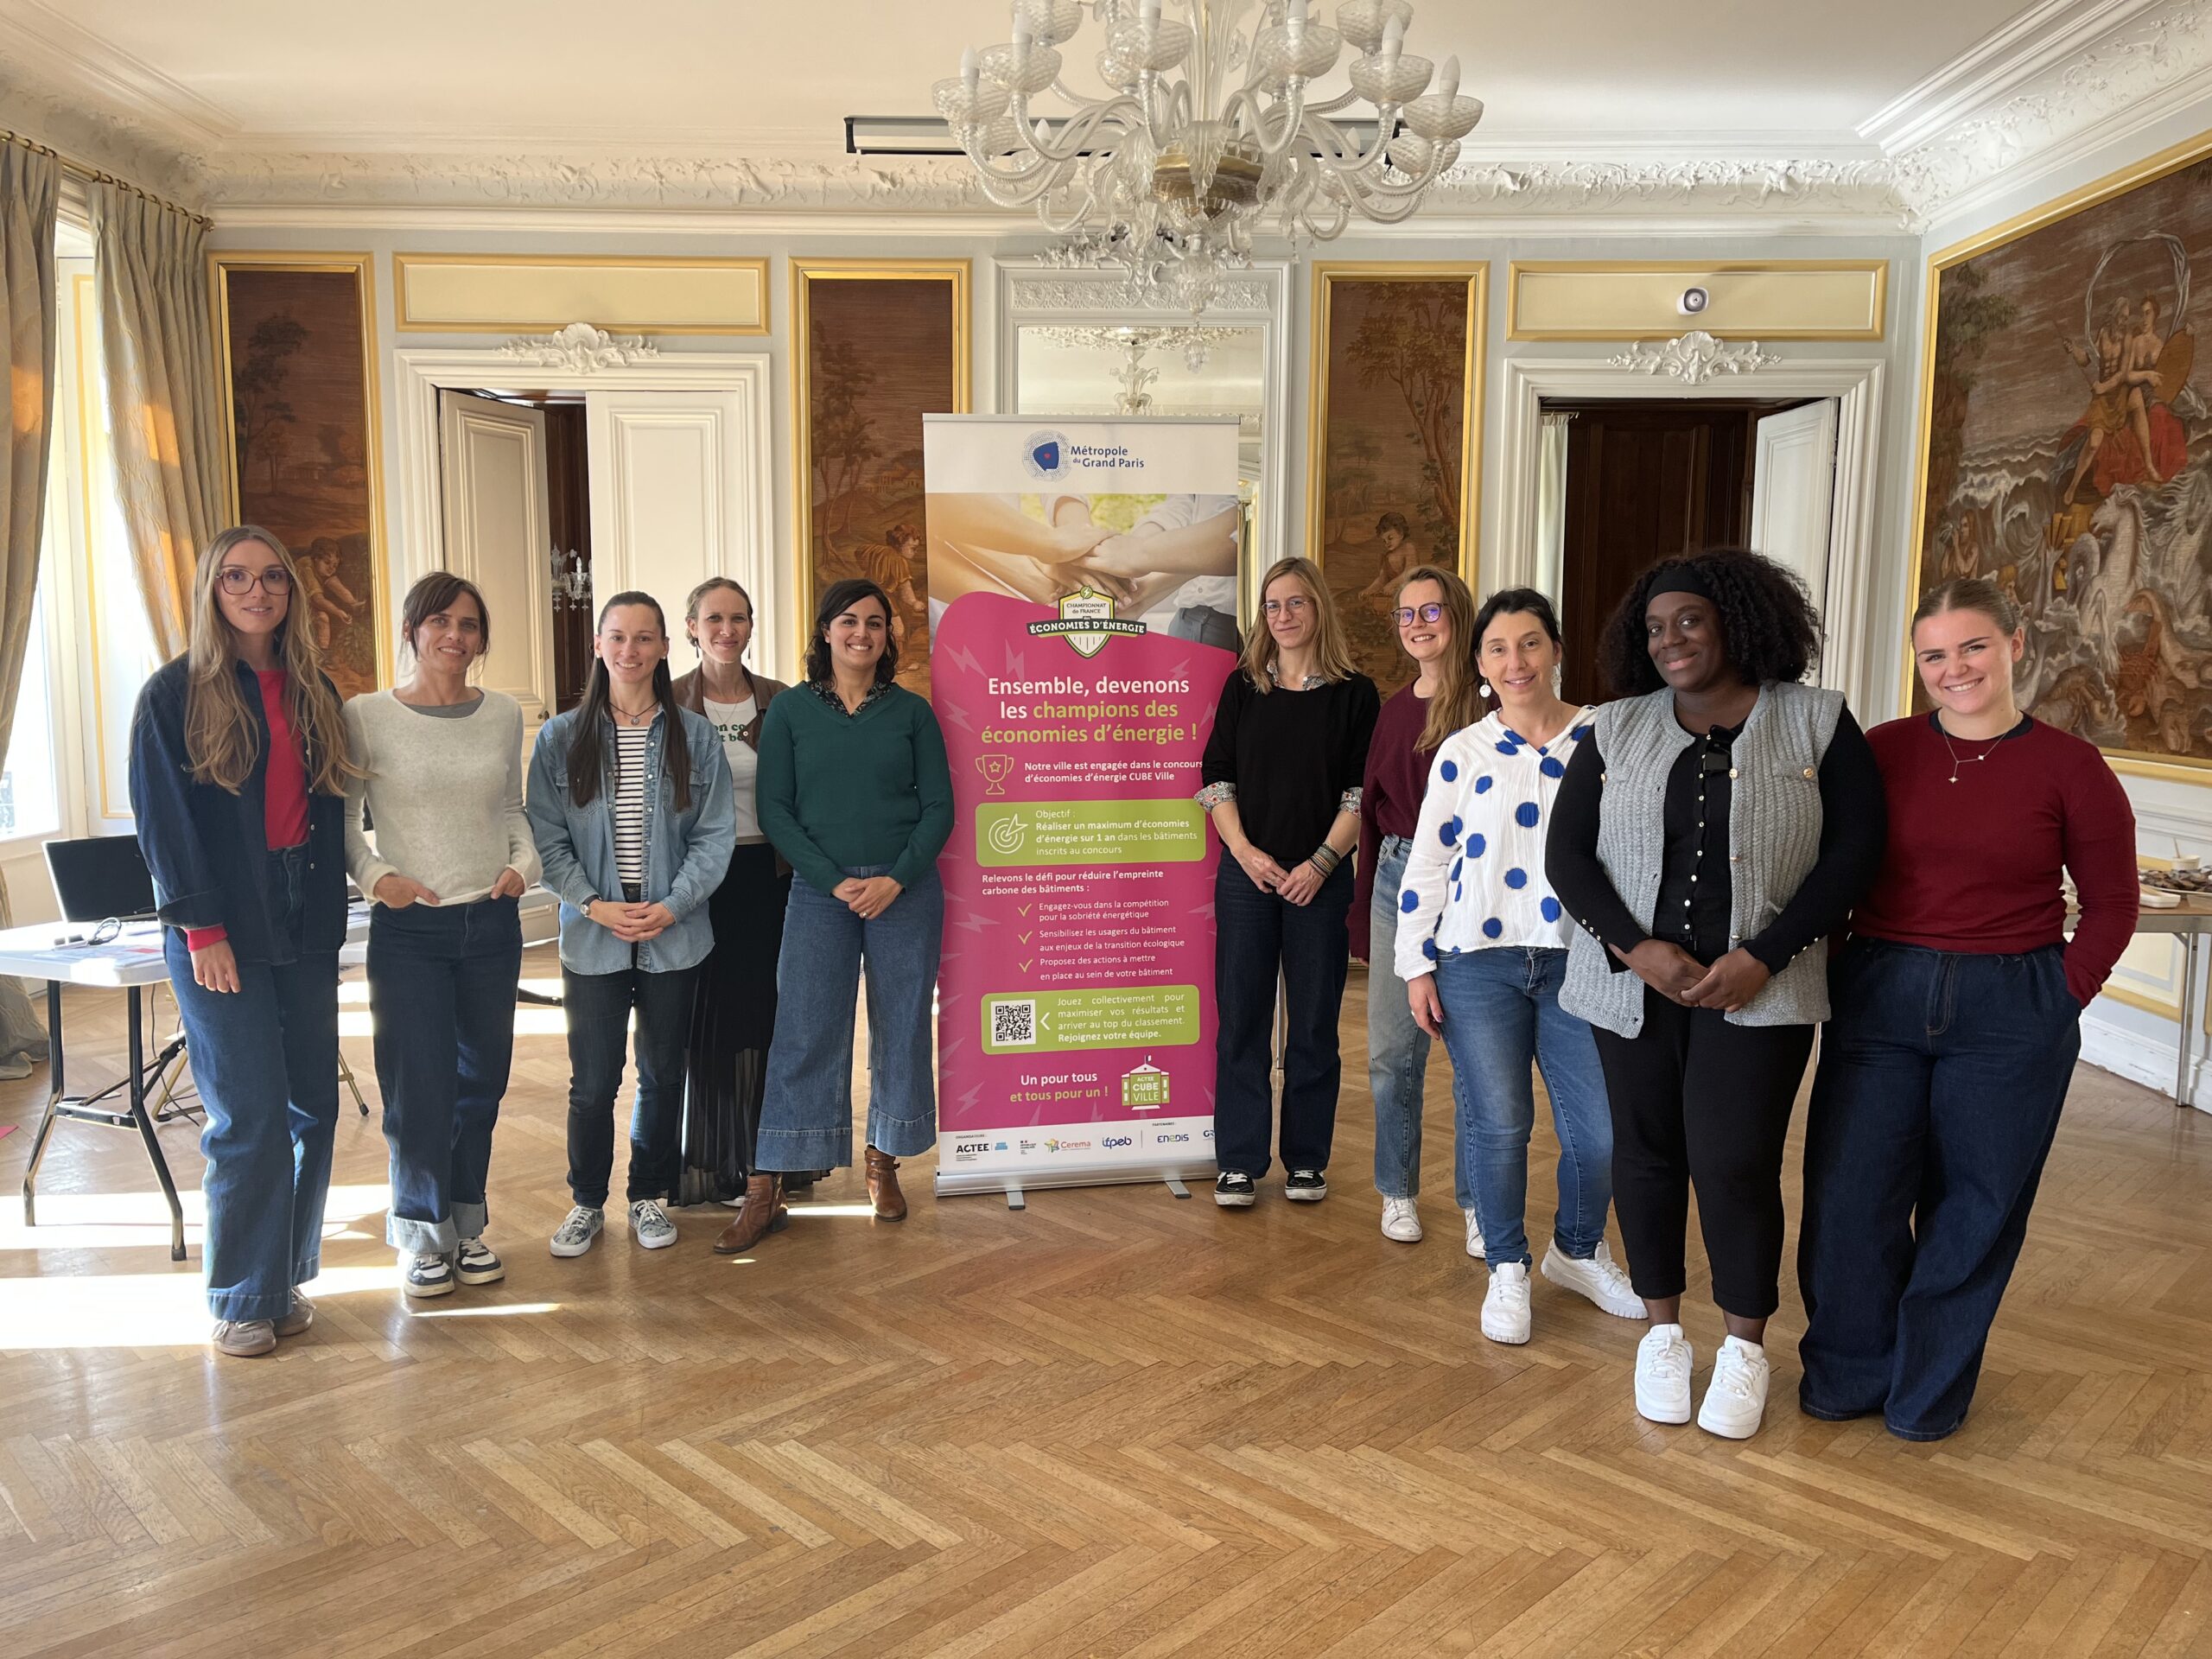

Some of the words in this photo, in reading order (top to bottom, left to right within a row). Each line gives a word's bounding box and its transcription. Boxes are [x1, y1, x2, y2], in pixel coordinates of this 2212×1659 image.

[1071, 446, 1128, 458] Métropole
[1083, 458, 1115, 467] Grand
[1119, 458, 1144, 467] Paris
[1029, 620, 1090, 634] ÉCONOMIES
[1093, 620, 1145, 633] D’ÉNERGIE
[988, 677, 1089, 696] Ensemble,
[1096, 677, 1189, 693] devenons
[1001, 702, 1027, 719] les
[1033, 701, 1139, 721] champions
[1145, 700, 1178, 717] des
[982, 726, 1088, 743] économies
[1094, 724, 1185, 745] d’énergie
[1192, 723, 1197, 740] !
[1025, 762, 1051, 771] Notre
[1053, 761, 1071, 771] ville
[1090, 760, 1128, 772] engagée
[1130, 760, 1150, 769] dans
[1153, 760, 1160, 769] le
[1163, 760, 1203, 769] concours
[1025, 772, 1082, 783] d’économies
[1085, 772, 1127, 783] d’énergie
[1129, 772, 1152, 781] CUBE
[1036, 810, 1071, 820] Objectif
[1037, 822, 1071, 830] Réaliser
[1088, 821, 1131, 830] maximum
[1134, 820, 1189, 829] d’économies
[1037, 834, 1077, 845] d’énergie
[1118, 833, 1138, 842] dans
[1154, 830, 1197, 840] bâtiments
[1037, 847, 1066, 855] inscrits
[1083, 846, 1122, 855] concours
[982, 874, 1022, 883] Relevons
[1036, 872, 1052, 881] défi
[1055, 873, 1076, 883] pour
[1078, 871, 1110, 880] réduire
[1114, 869, 1163, 880] l’empreinte
[982, 886, 1019, 895] carbone
[1021, 885, 1037, 893] des
[1039, 883, 1084, 893] bâtiments
[1039, 902, 1091, 912] Engagez-vous
[1123, 899, 1168, 909] compétition
[1039, 913, 1058, 922] pour
[1103, 910, 1148, 920] énergétique
[1040, 929, 1083, 938] Sensibilisez
[1056, 944, 1081, 952] enjeux
[1104, 940, 1141, 949] transition
[1143, 939, 1185, 949] écologique
[1040, 958, 1075, 967] Proposez
[1052, 972, 1072, 981] place
[1104, 969, 1114, 978] de
[1139, 968, 1173, 976] bâtiment
[1058, 998, 1081, 1007] Jouez
[1092, 995, 1154, 1004] collectivement
[1165, 994, 1184, 1002] pour
[1058, 1008, 1102, 1018] maximiser
[1132, 1006, 1168, 1014] résultats
[1058, 1021, 1086, 1030] arriver
[1103, 1020, 1118, 1029] top
[1122, 1019, 1132, 1027] du
[1135, 1017, 1185, 1027] classement.
[1058, 1033, 1101, 1043] Rejoignez
[1128, 1030, 1161, 1039] équipe.
[1021, 1075, 1037, 1085] Un
[1041, 1074, 1068, 1087] pour
[1071, 1072, 1097, 1082] tous
[1133, 1083, 1159, 1091] CUBE
[1010, 1092, 1022, 1103] et
[1025, 1090, 1051, 1101] tous
[1055, 1090, 1082, 1103] pour
[1086, 1089, 1100, 1097] un
[1105, 1086, 1109, 1096] !
[1133, 1091, 1159, 1102] VILLE
[956, 1143, 989, 1153] ACTEE
